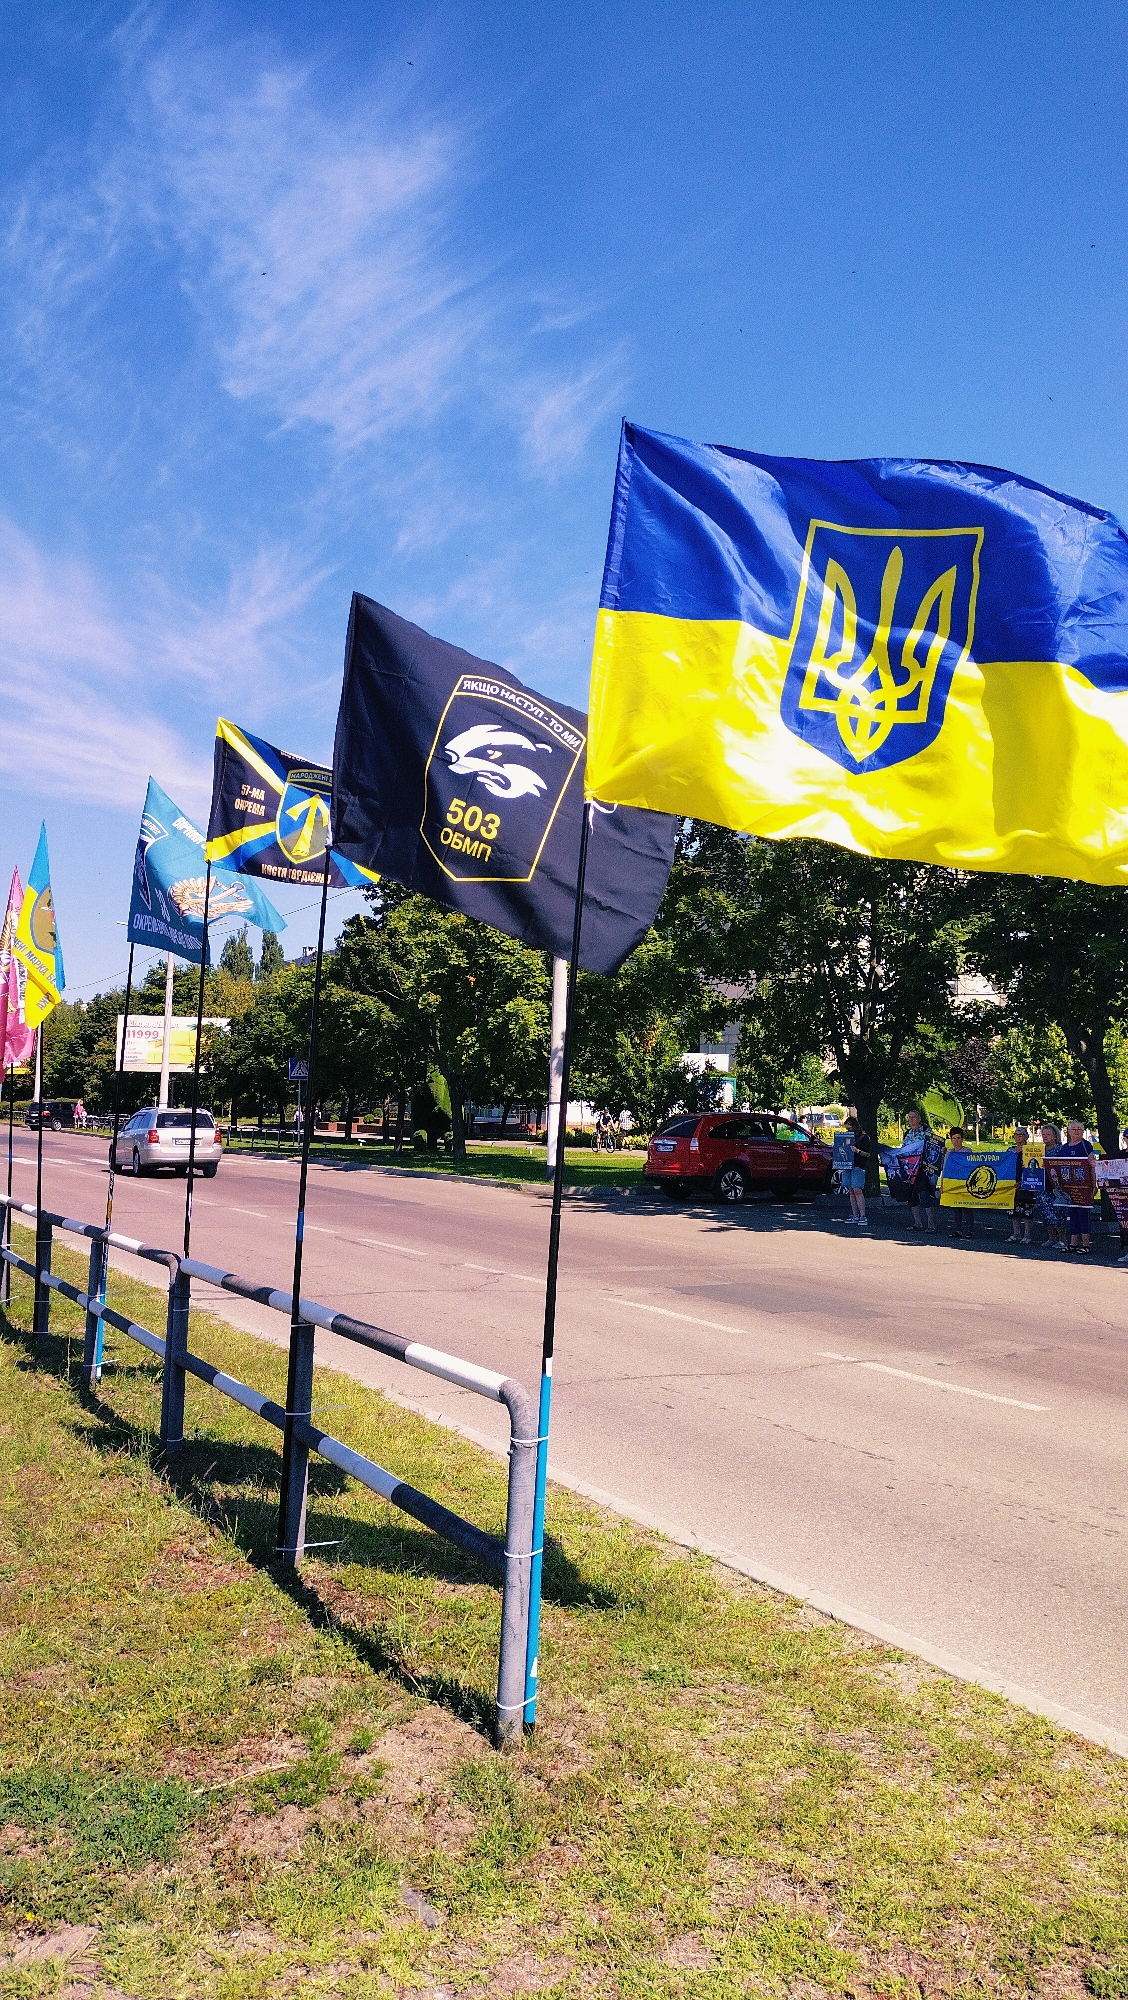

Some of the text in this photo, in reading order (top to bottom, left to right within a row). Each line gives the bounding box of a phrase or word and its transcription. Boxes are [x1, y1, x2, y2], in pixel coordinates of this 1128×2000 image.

[462, 680, 500, 695] ЯКЩО
[501, 690, 545, 719] НАСТУП
[547, 718, 564, 733] ТО
[561, 731, 582, 748] МИ
[290, 772, 329, 782] НАРОДЖЕНІ
[240, 783, 266, 801] 57-МА
[234, 798, 266, 817] ОКРЕМА
[446, 797, 501, 840] 503
[440, 827, 492, 863] ОБМП
[261, 863, 288, 879] КОСТЯ
[25, 950, 49, 976] МАРКА
[126, 1029, 159, 1039] 11999
